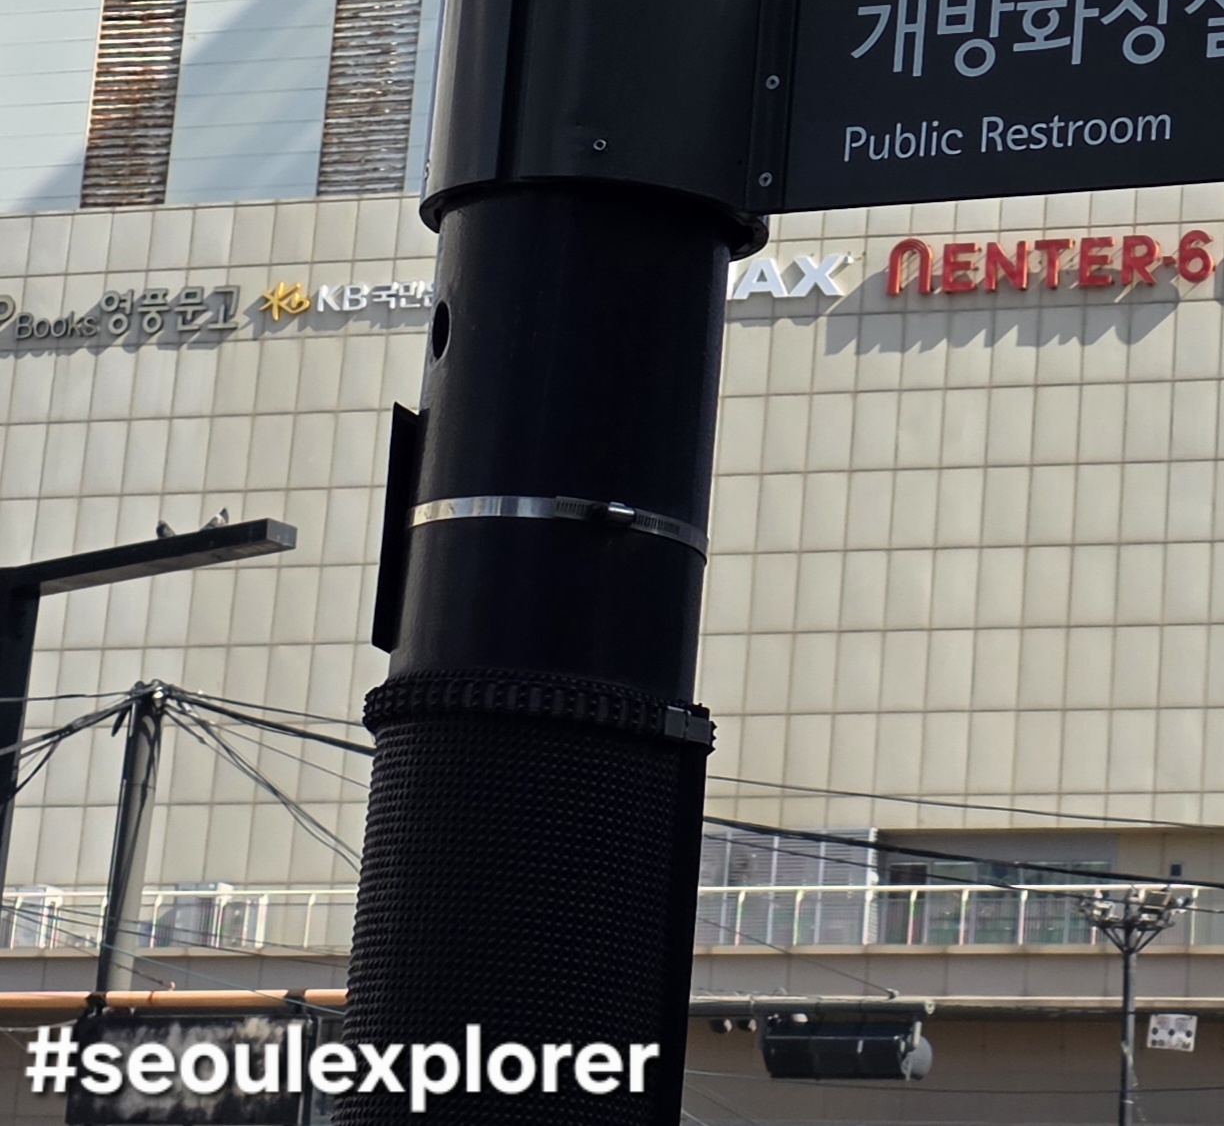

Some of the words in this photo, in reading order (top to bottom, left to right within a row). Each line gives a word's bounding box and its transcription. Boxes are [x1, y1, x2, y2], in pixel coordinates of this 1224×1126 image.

[844, 122, 963, 162] Public
[980, 113, 1172, 153] Restroom
[727, 254, 846, 300] AX
[15, 310, 98, 340] Books
[100, 285, 239, 335] 영풍문고
